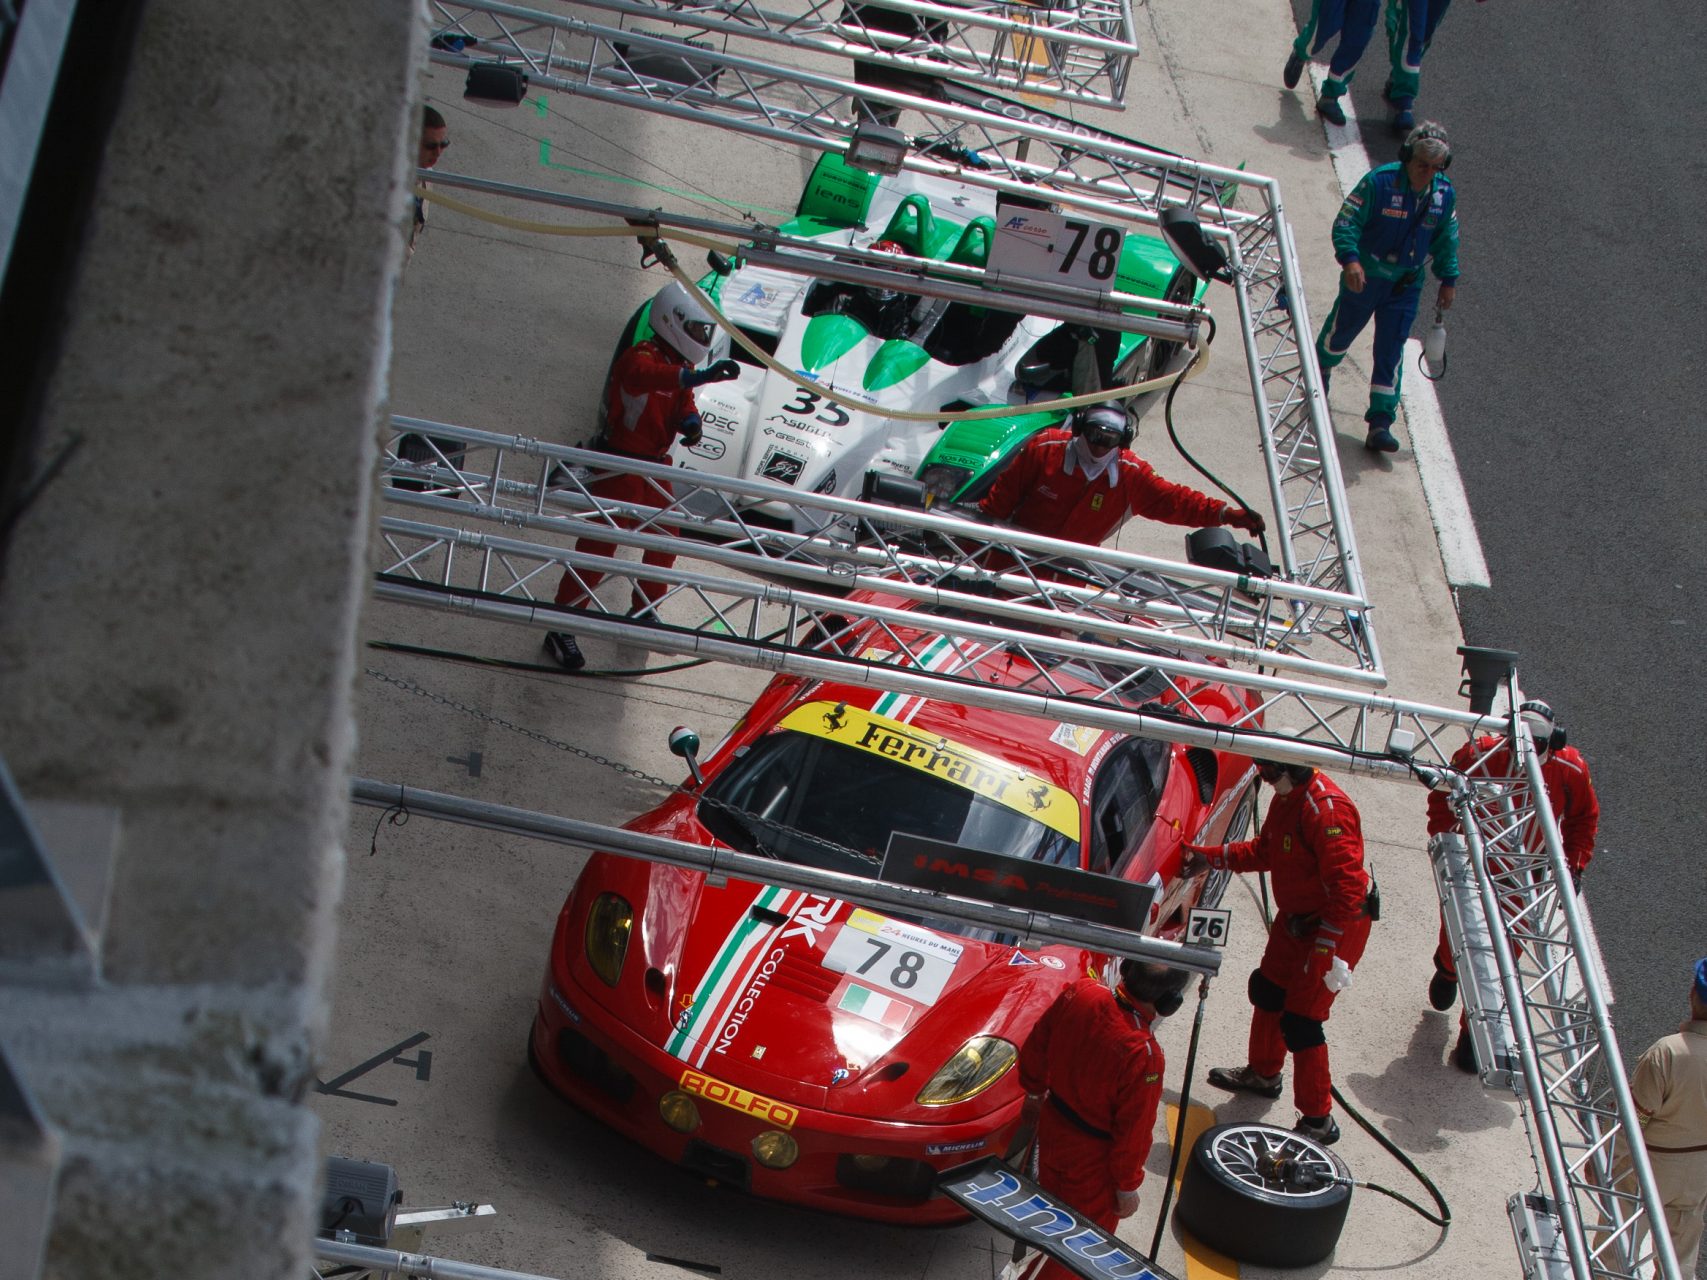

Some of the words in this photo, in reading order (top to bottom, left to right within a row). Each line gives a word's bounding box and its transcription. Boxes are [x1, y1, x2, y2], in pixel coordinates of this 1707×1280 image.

[1058, 220, 1121, 281] 78
[700, 411, 739, 433] IDEC
[782, 387, 850, 427] 35
[856, 722, 1016, 801] Ferrari
[914, 854, 1029, 892] IMSA
[880, 925, 901, 939] 24
[901, 933, 928, 946] HEURES
[928, 940, 939, 948] DU
[940, 944, 961, 955] MANS
[1191, 915, 1224, 939] 76
[855, 937, 925, 990] 78
[715, 948, 785, 1055] COLLECTION
[681, 1072, 794, 1125] ROLFO
[942, 1140, 985, 1151] MICHELIN
